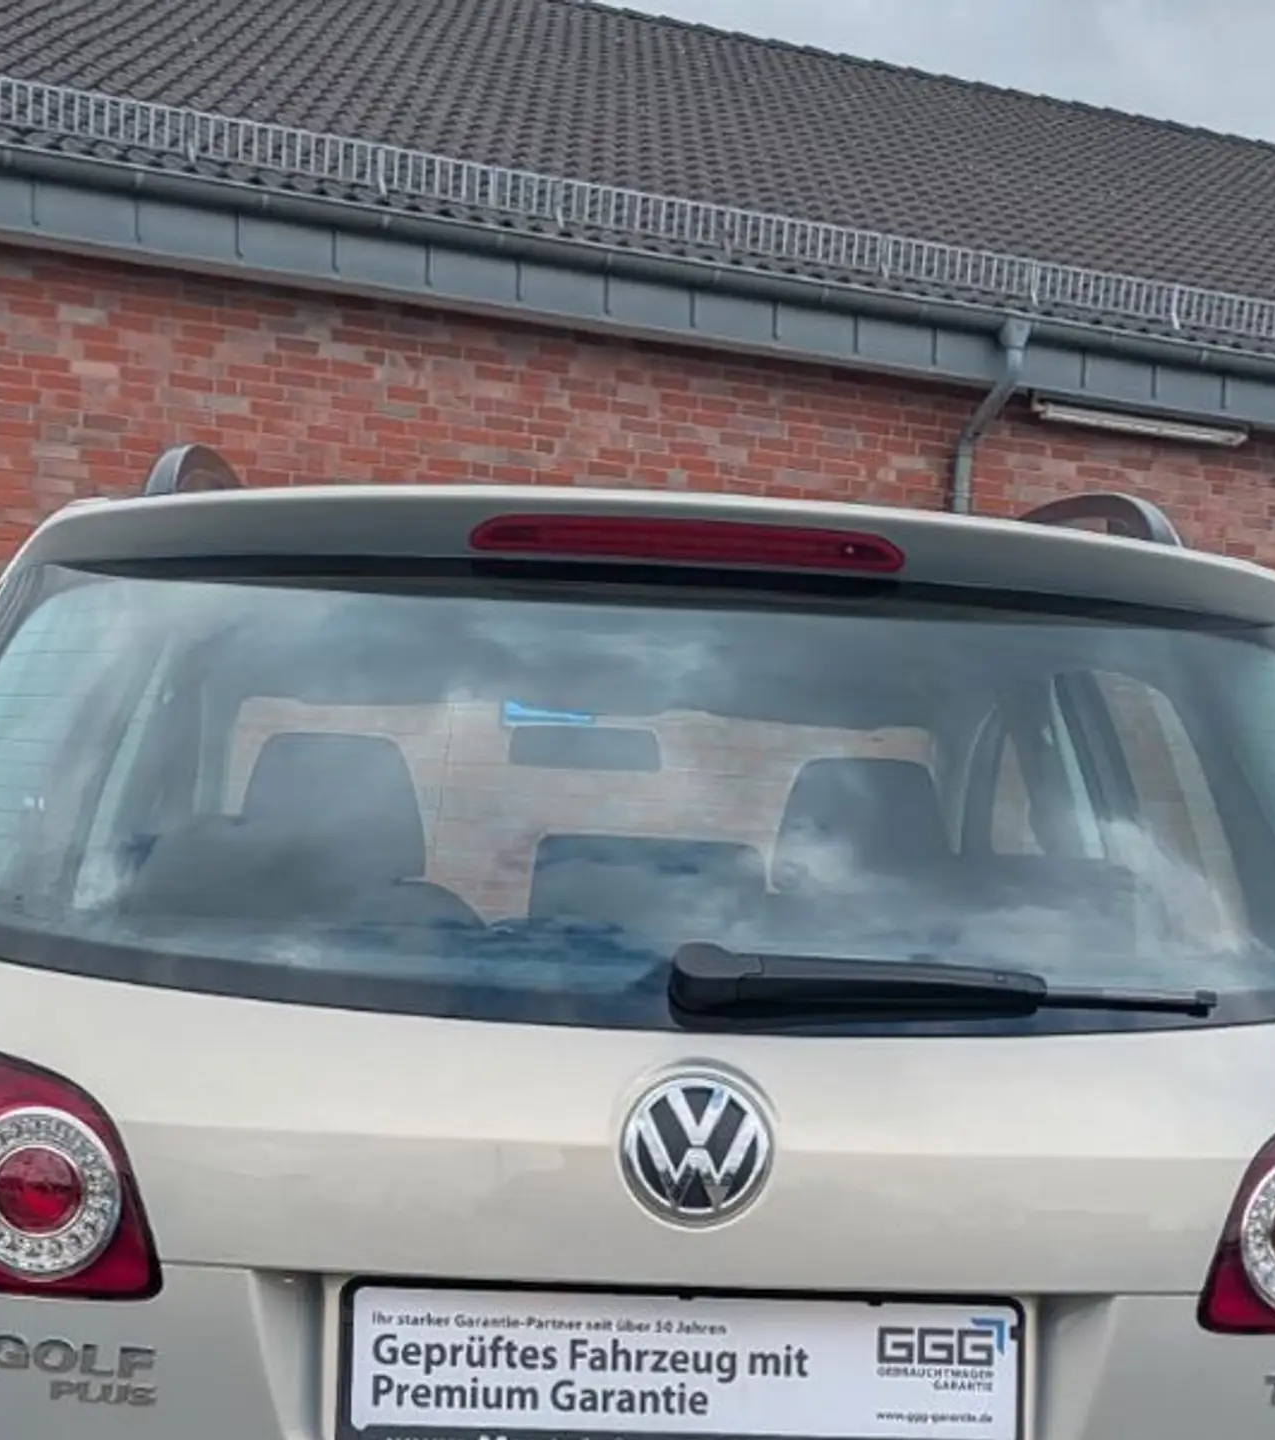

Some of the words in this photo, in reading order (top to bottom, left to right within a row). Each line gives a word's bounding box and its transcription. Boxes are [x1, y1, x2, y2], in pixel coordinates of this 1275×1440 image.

[396, 1312, 450, 1327] starker
[454, 1314, 582, 1330] Garantie-Partner
[372, 1333, 558, 1375] Geprüftes
[569, 1339, 738, 1384] Fahrzeug
[748, 1345, 809, 1378] mit
[877, 1326, 994, 1366] GGG
[49, 1380, 157, 1407] PLUS
[372, 1374, 539, 1410] Premium
[550, 1380, 709, 1415] Garantie
[933, 1380, 993, 1392] GARANTIE
